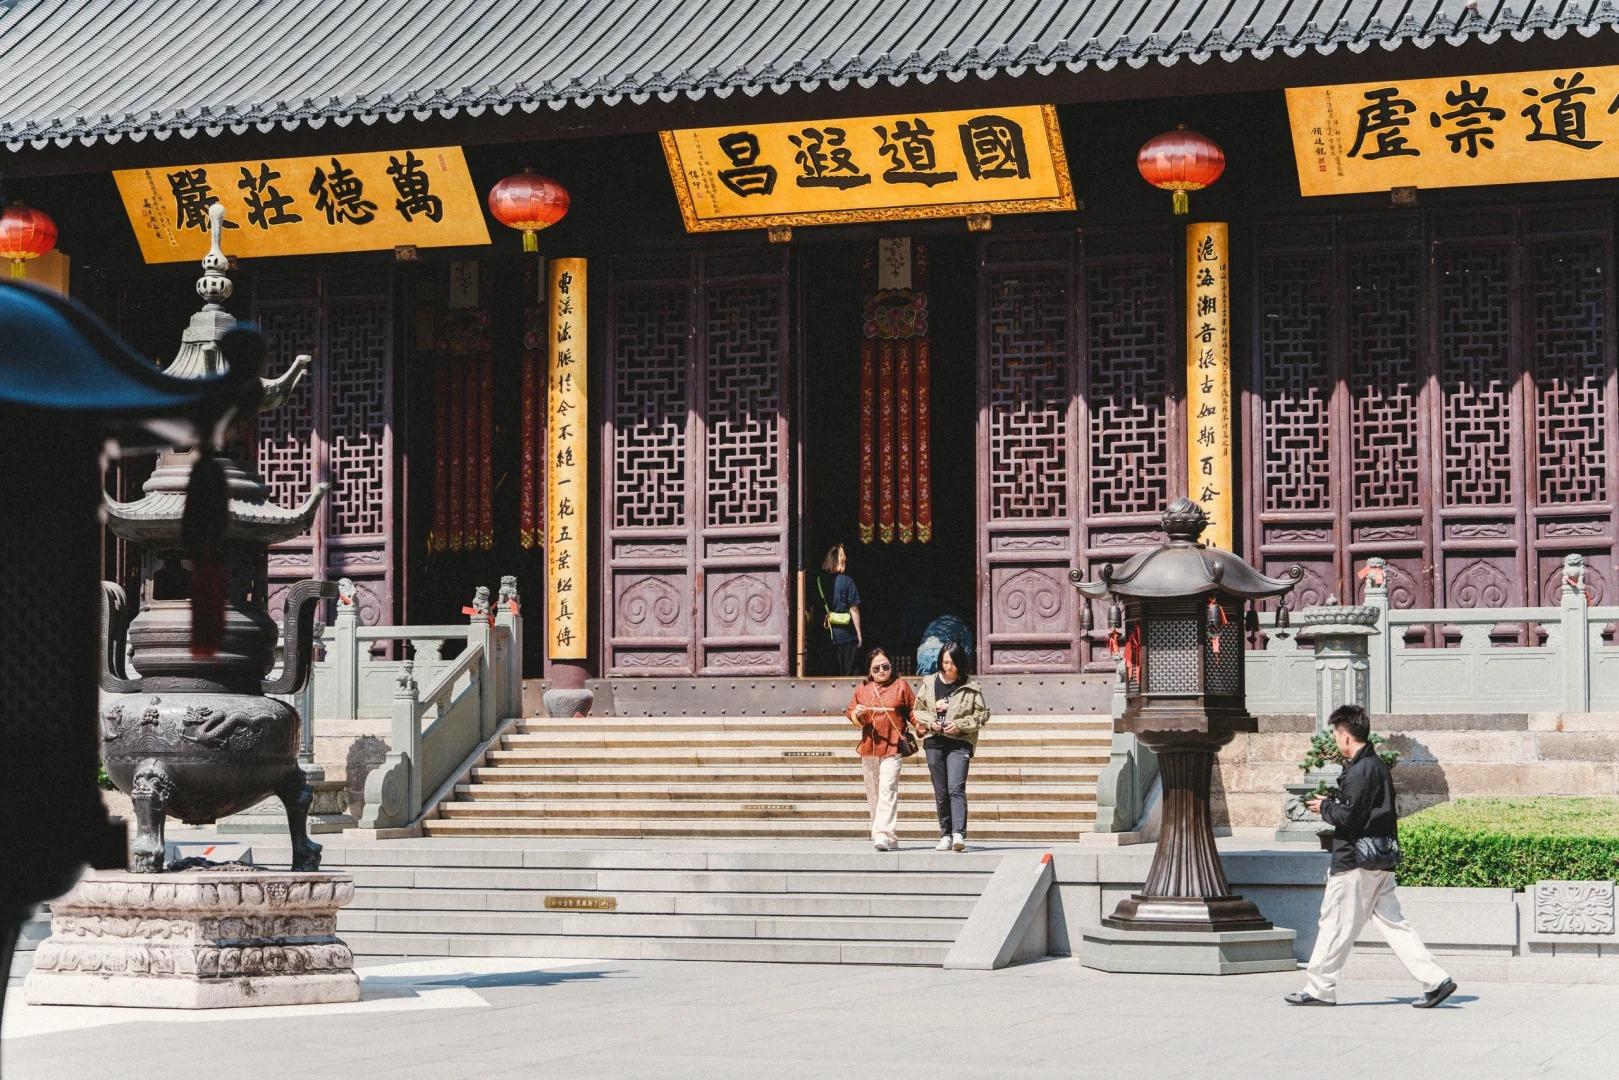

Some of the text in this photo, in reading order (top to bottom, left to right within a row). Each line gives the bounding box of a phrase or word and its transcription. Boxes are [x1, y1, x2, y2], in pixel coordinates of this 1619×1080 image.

[1346, 71, 1619, 160] 道崇虛
[167, 151, 443, 232] 萬德莊嚴
